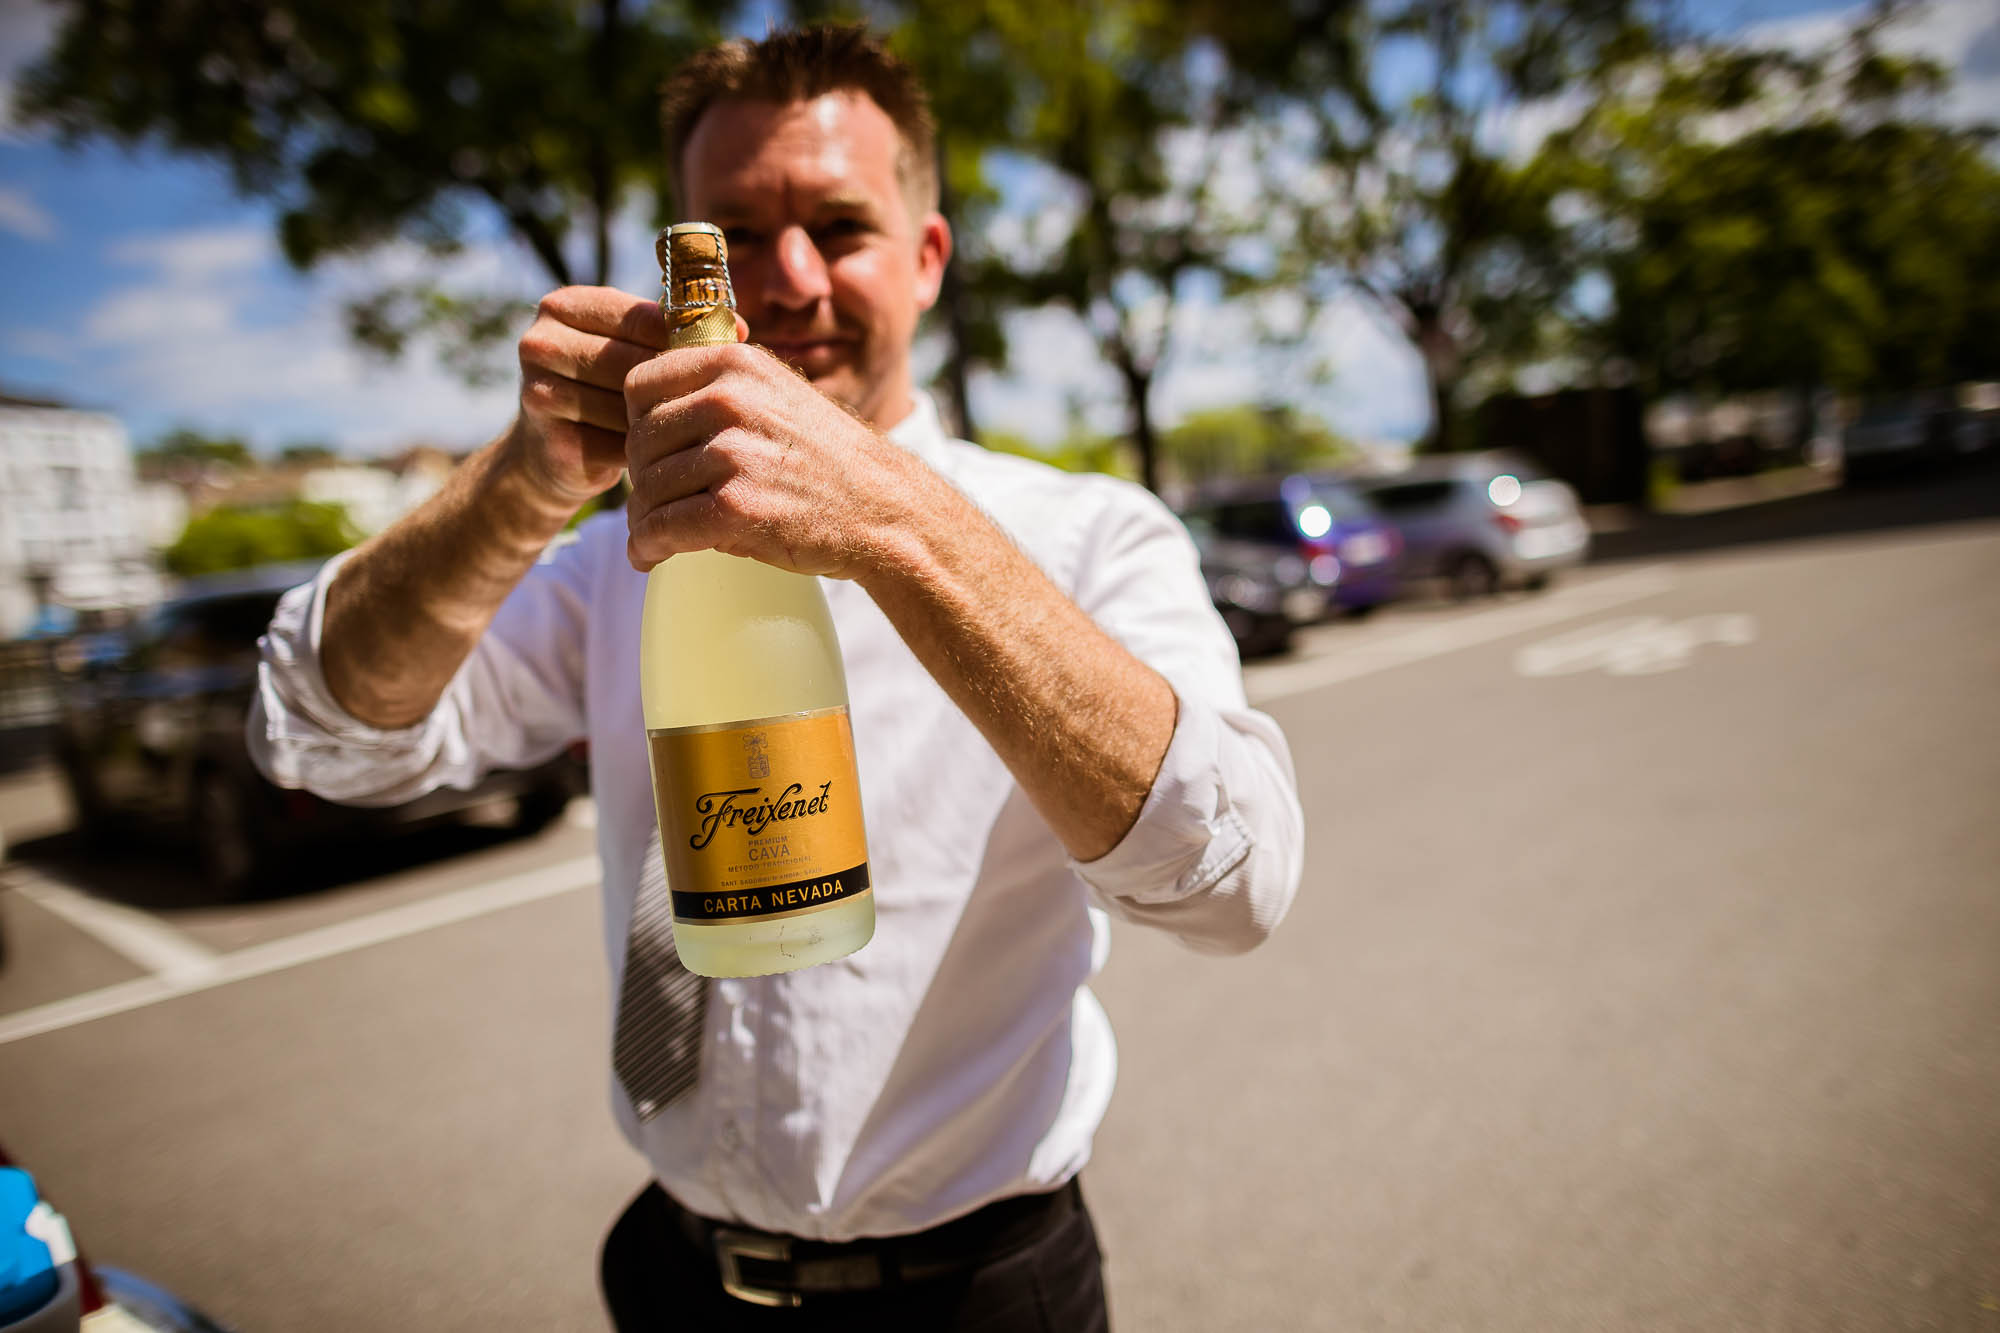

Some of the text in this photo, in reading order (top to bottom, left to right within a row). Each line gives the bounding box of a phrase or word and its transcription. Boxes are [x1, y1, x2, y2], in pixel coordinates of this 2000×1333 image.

[690, 780, 832, 850] Freixenet
[748, 835, 788, 846] PREMIUM
[748, 844, 791, 861] CAVA
[704, 879, 844, 913] CARTA NEVADA
